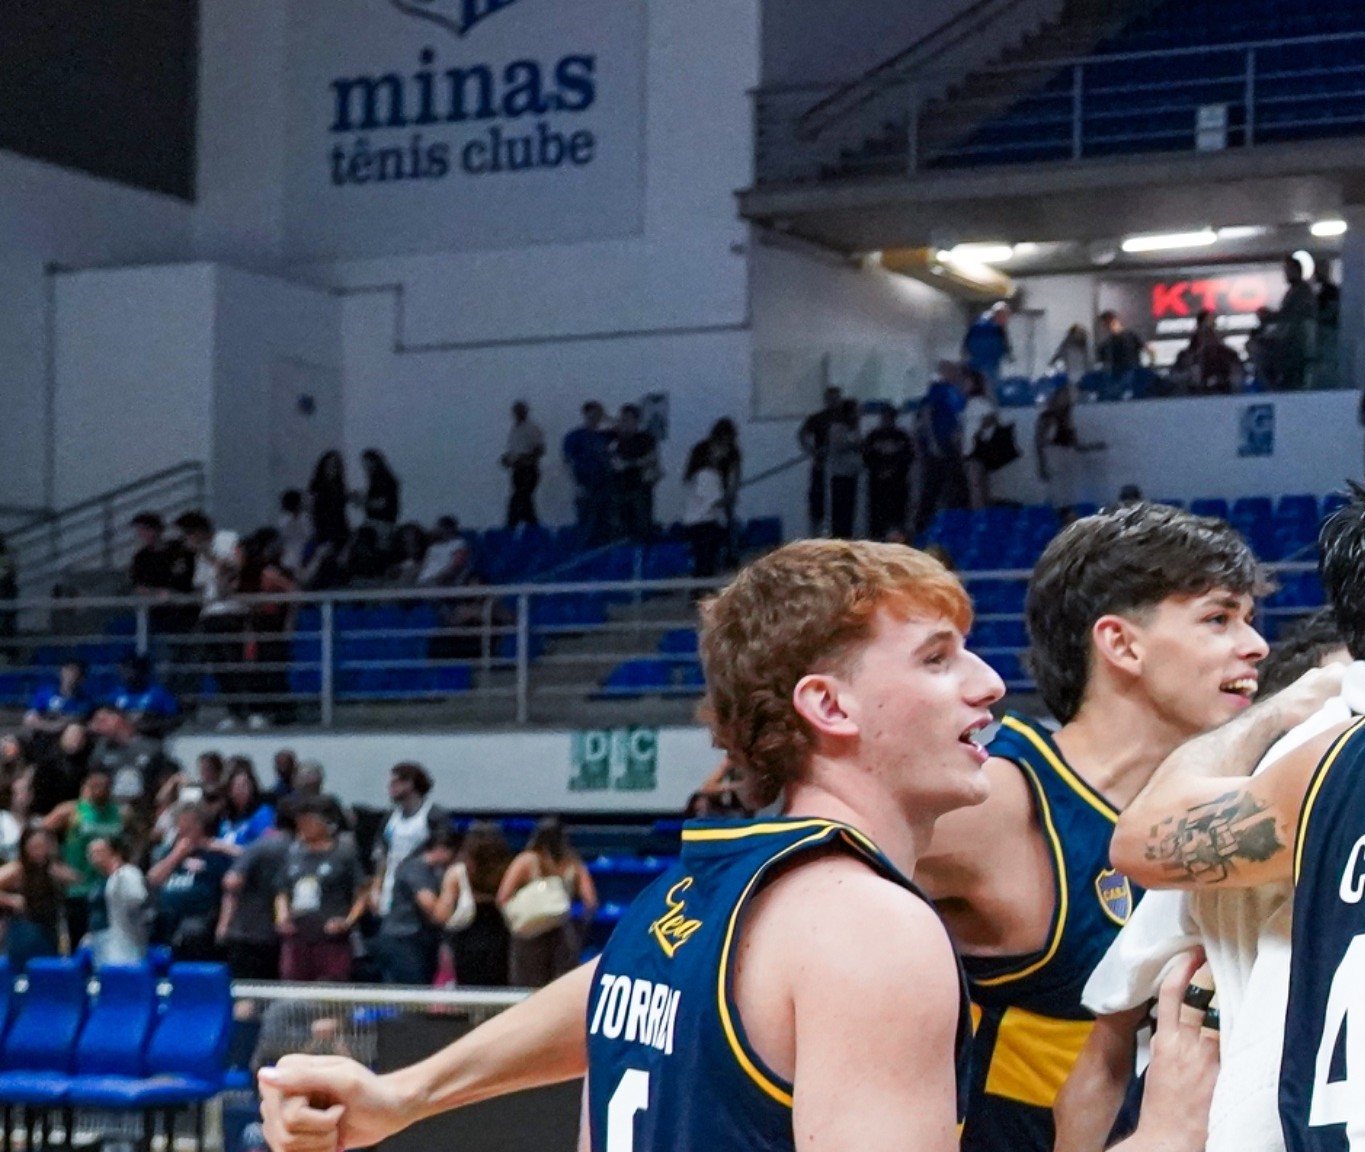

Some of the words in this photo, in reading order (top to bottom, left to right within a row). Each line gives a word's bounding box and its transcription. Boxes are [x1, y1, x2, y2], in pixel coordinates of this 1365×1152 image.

[329, 46, 597, 132] minas
[329, 133, 451, 186] tênis
[461, 121, 595, 174] clube
[1152, 277, 1268, 317] KTO
